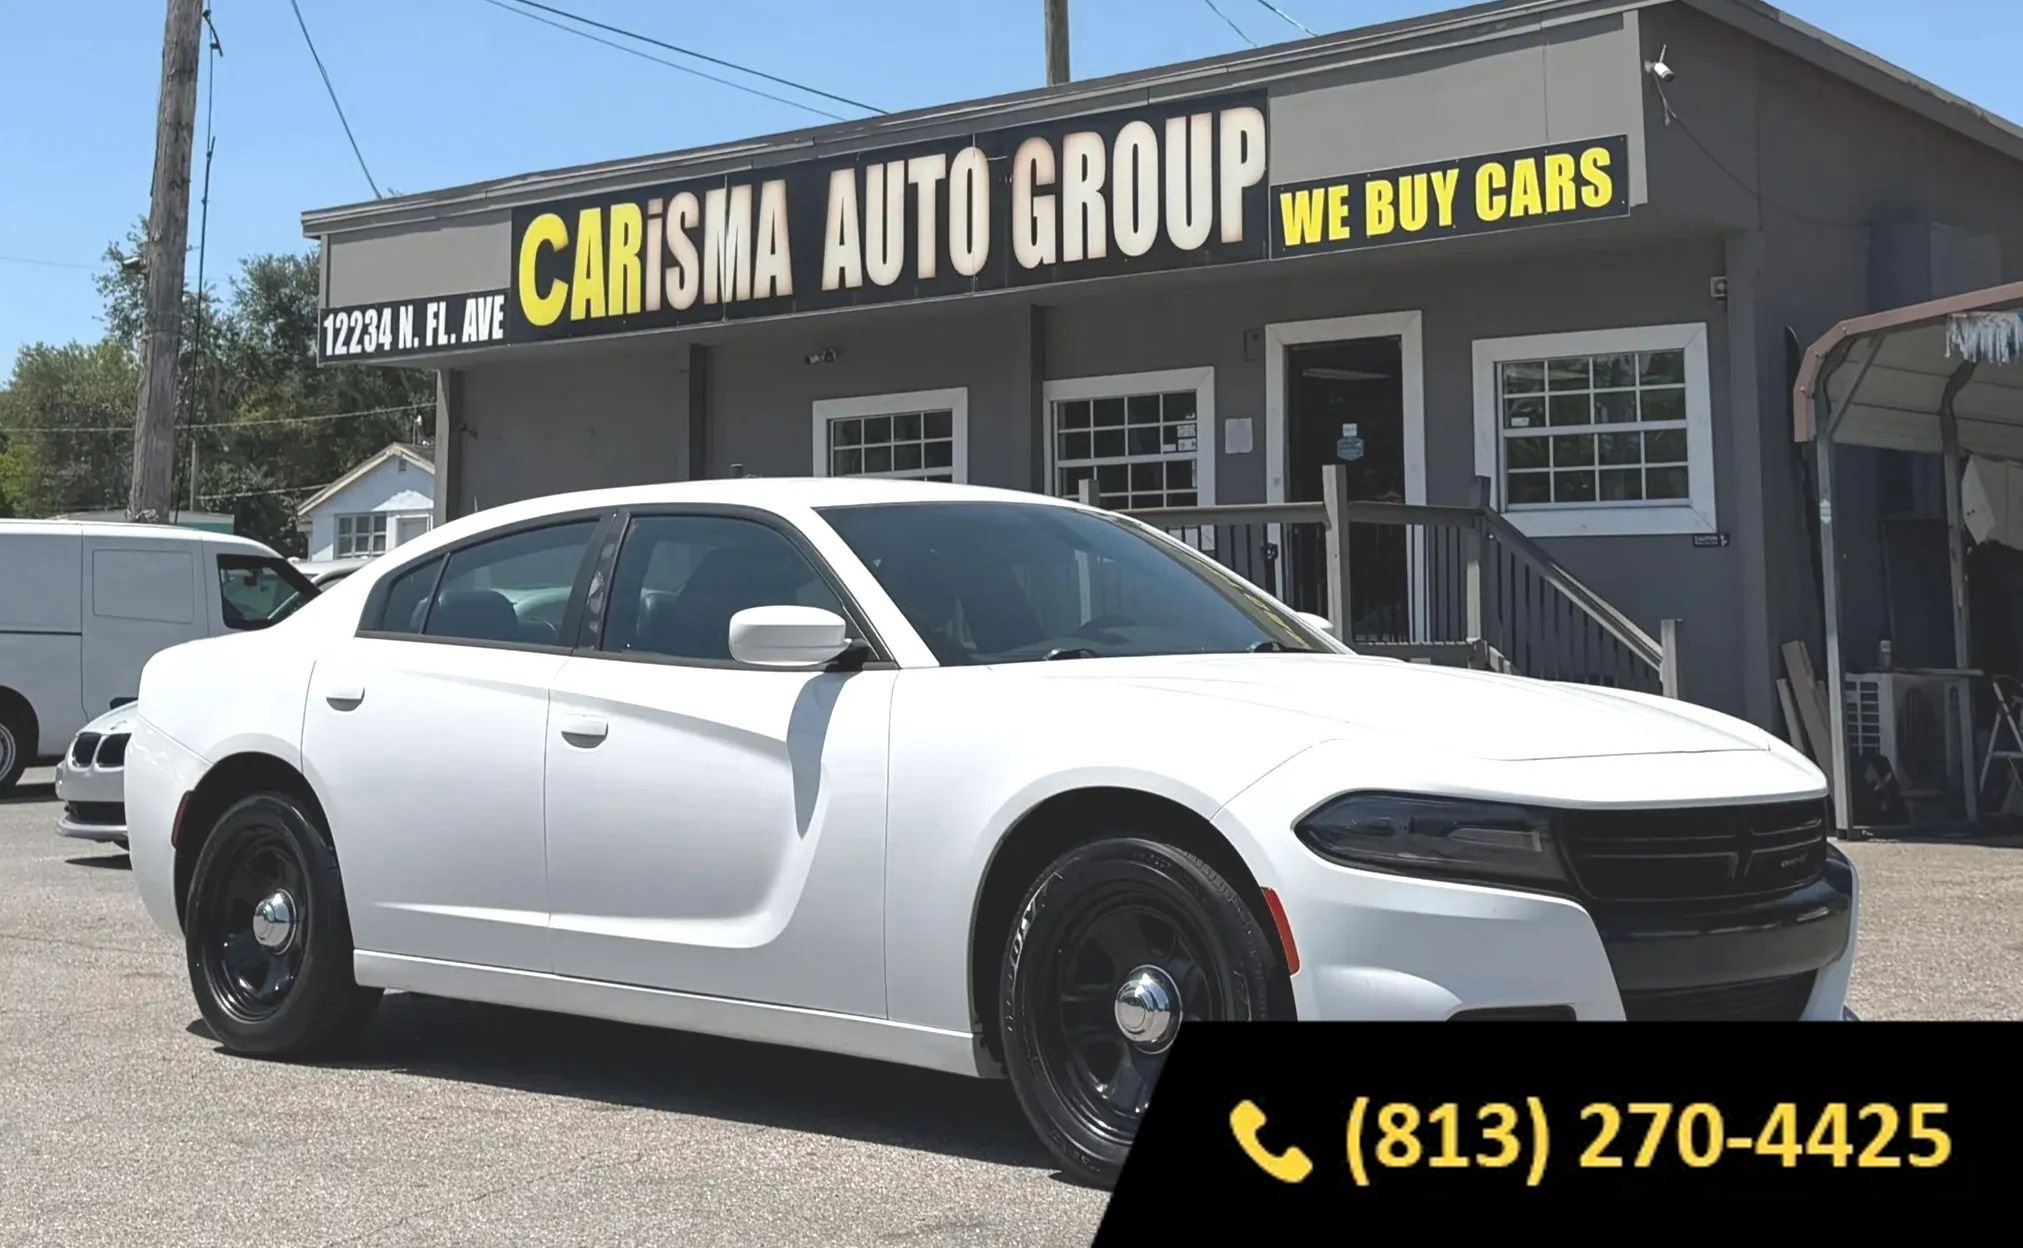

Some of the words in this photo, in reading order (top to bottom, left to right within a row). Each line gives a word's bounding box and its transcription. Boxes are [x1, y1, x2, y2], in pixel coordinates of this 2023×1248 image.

[822, 146, 990, 291] AUTO
[1012, 106, 1266, 270] GROUP
[1280, 184, 1350, 246] WE
[1366, 168, 1459, 237] BUY
[1475, 147, 1613, 222] CARS
[323, 307, 393, 356] 12234
[398, 304, 420, 349] N.
[426, 301, 456, 347] FL.
[462, 295, 505, 343] AVE
